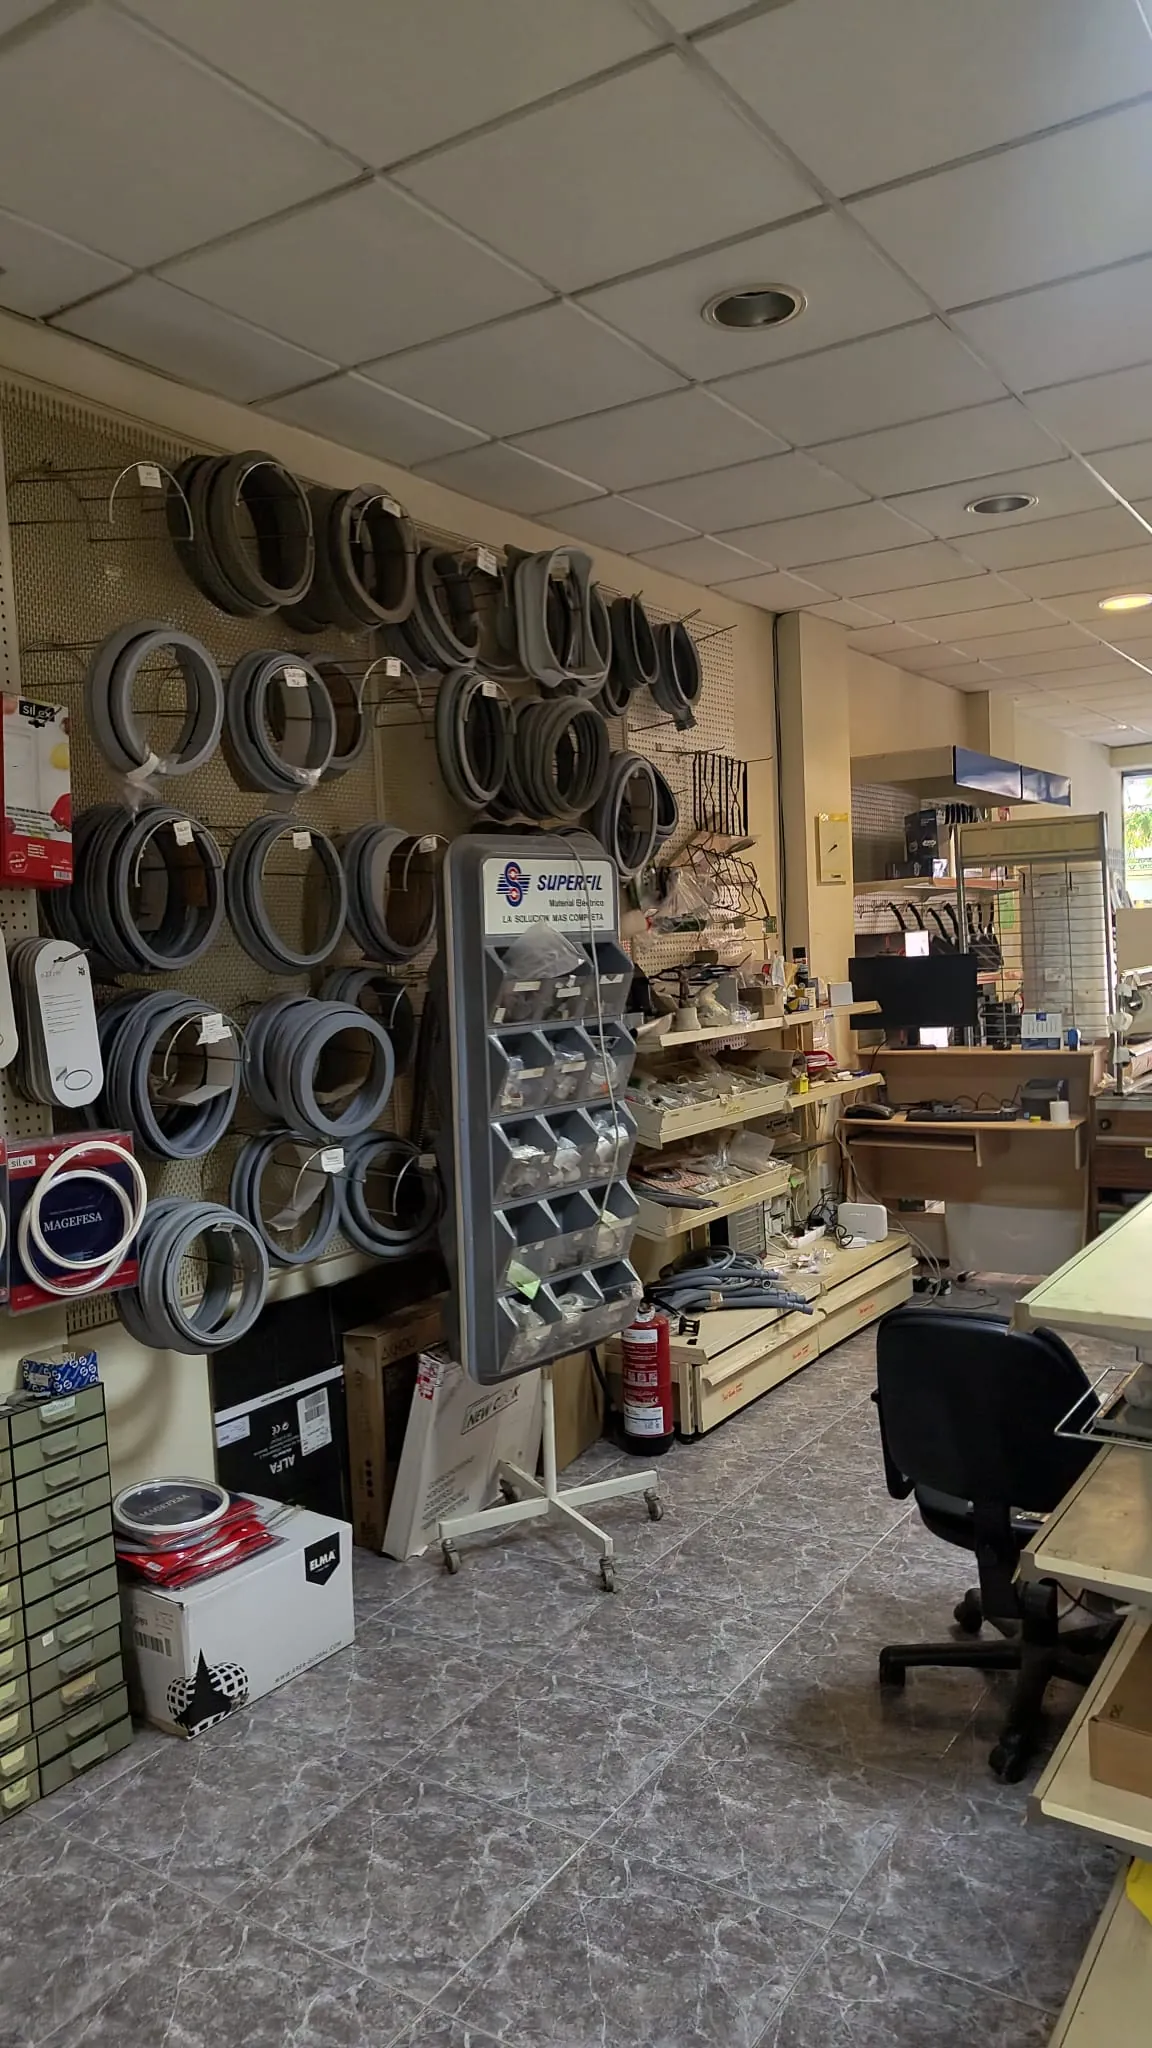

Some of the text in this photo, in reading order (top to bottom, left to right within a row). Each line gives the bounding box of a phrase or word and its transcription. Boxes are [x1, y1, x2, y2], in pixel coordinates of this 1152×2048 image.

[538, 874, 603, 891] SUPERFIL
[549, 899, 574, 907] Material
[502, 916, 512, 924] LA
[44, 1211, 103, 1232] MAGEFESA
[269, 1454, 295, 1474] ALFA
[139, 1493, 191, 1517] MAGEFESA
[309, 1551, 336, 1571] ELMA
